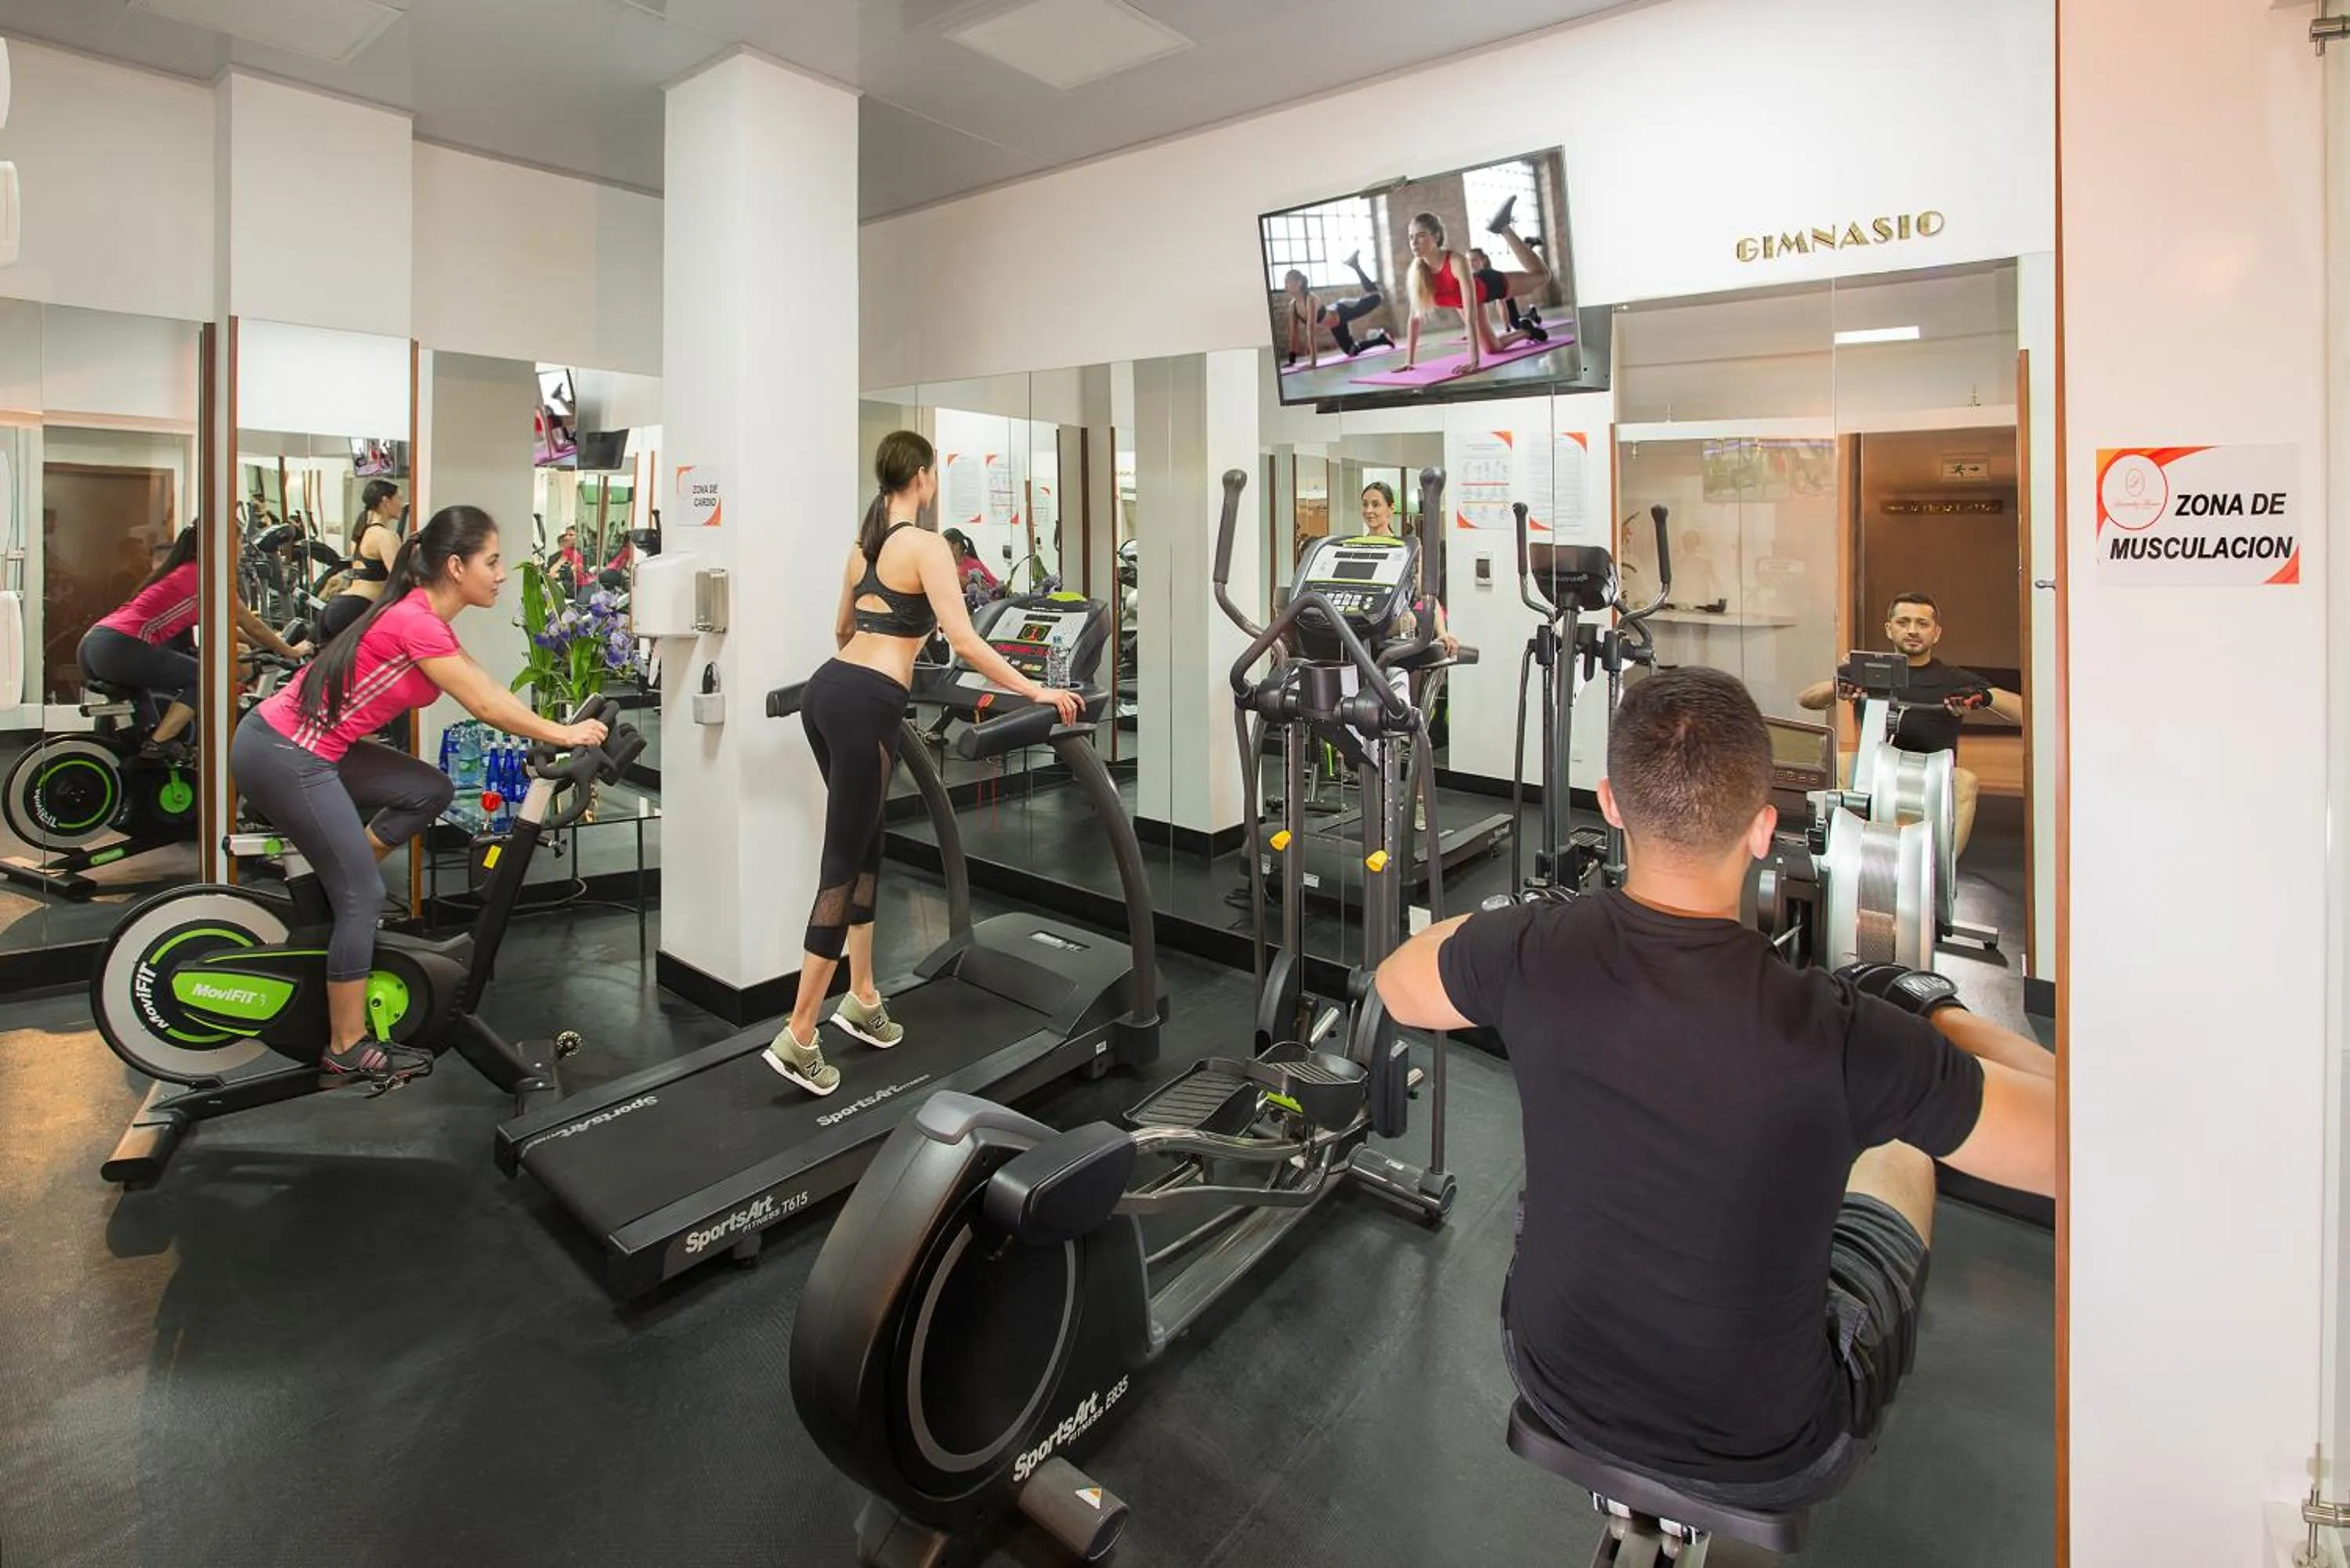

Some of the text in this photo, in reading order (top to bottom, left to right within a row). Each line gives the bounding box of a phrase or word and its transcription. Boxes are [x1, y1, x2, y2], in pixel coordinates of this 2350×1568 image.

[1737, 210, 1945, 263] GIMNASIO
[692, 483, 719, 494] ZONA DE
[2175, 494, 2243, 516] ZONA
[2251, 493, 2286, 515] DE
[2110, 537, 2293, 559] MUSCULACION
[136, 961, 169, 1028] MoviFIT
[192, 983, 258, 1004] MoviFIT
[816, 1084, 899, 1126] SportsArt
[685, 1190, 808, 1253] SportsArt T615
[743, 1209, 779, 1233] FITNESS
[1013, 1391, 1098, 1482] SportsArt
